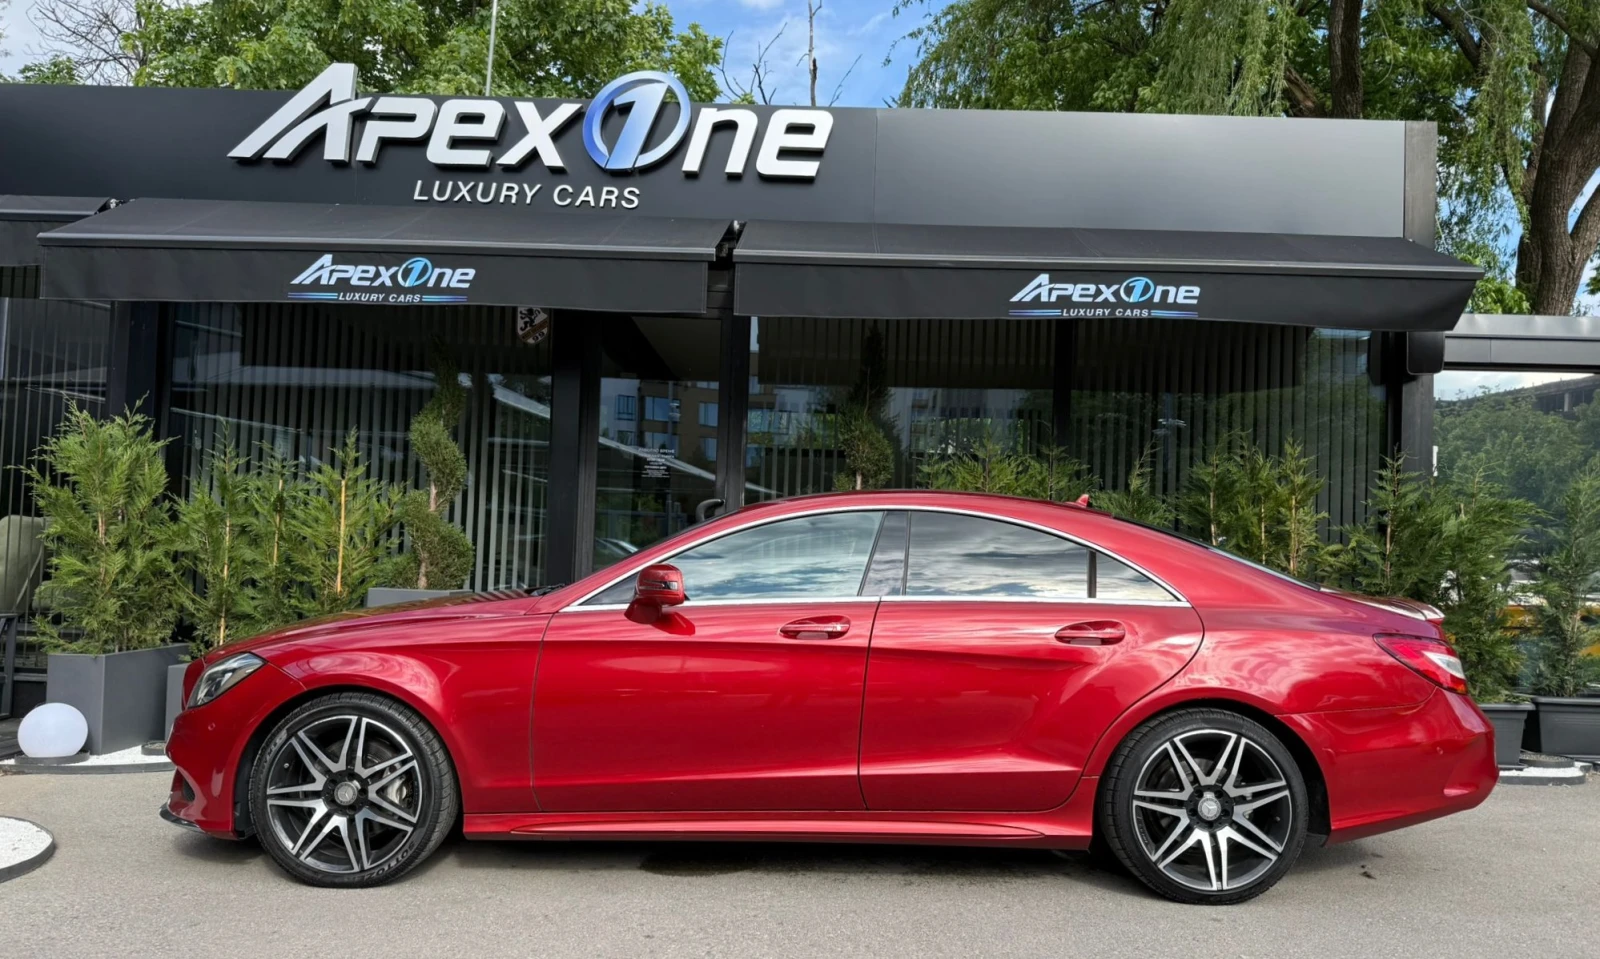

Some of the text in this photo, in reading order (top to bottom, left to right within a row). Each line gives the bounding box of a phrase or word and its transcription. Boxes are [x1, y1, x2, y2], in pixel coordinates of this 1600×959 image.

[413, 180, 641, 209] LUXURY CARS
[338, 291, 421, 304] LUXURY CARS
[1062, 308, 1149, 318] LUXURY CARS
